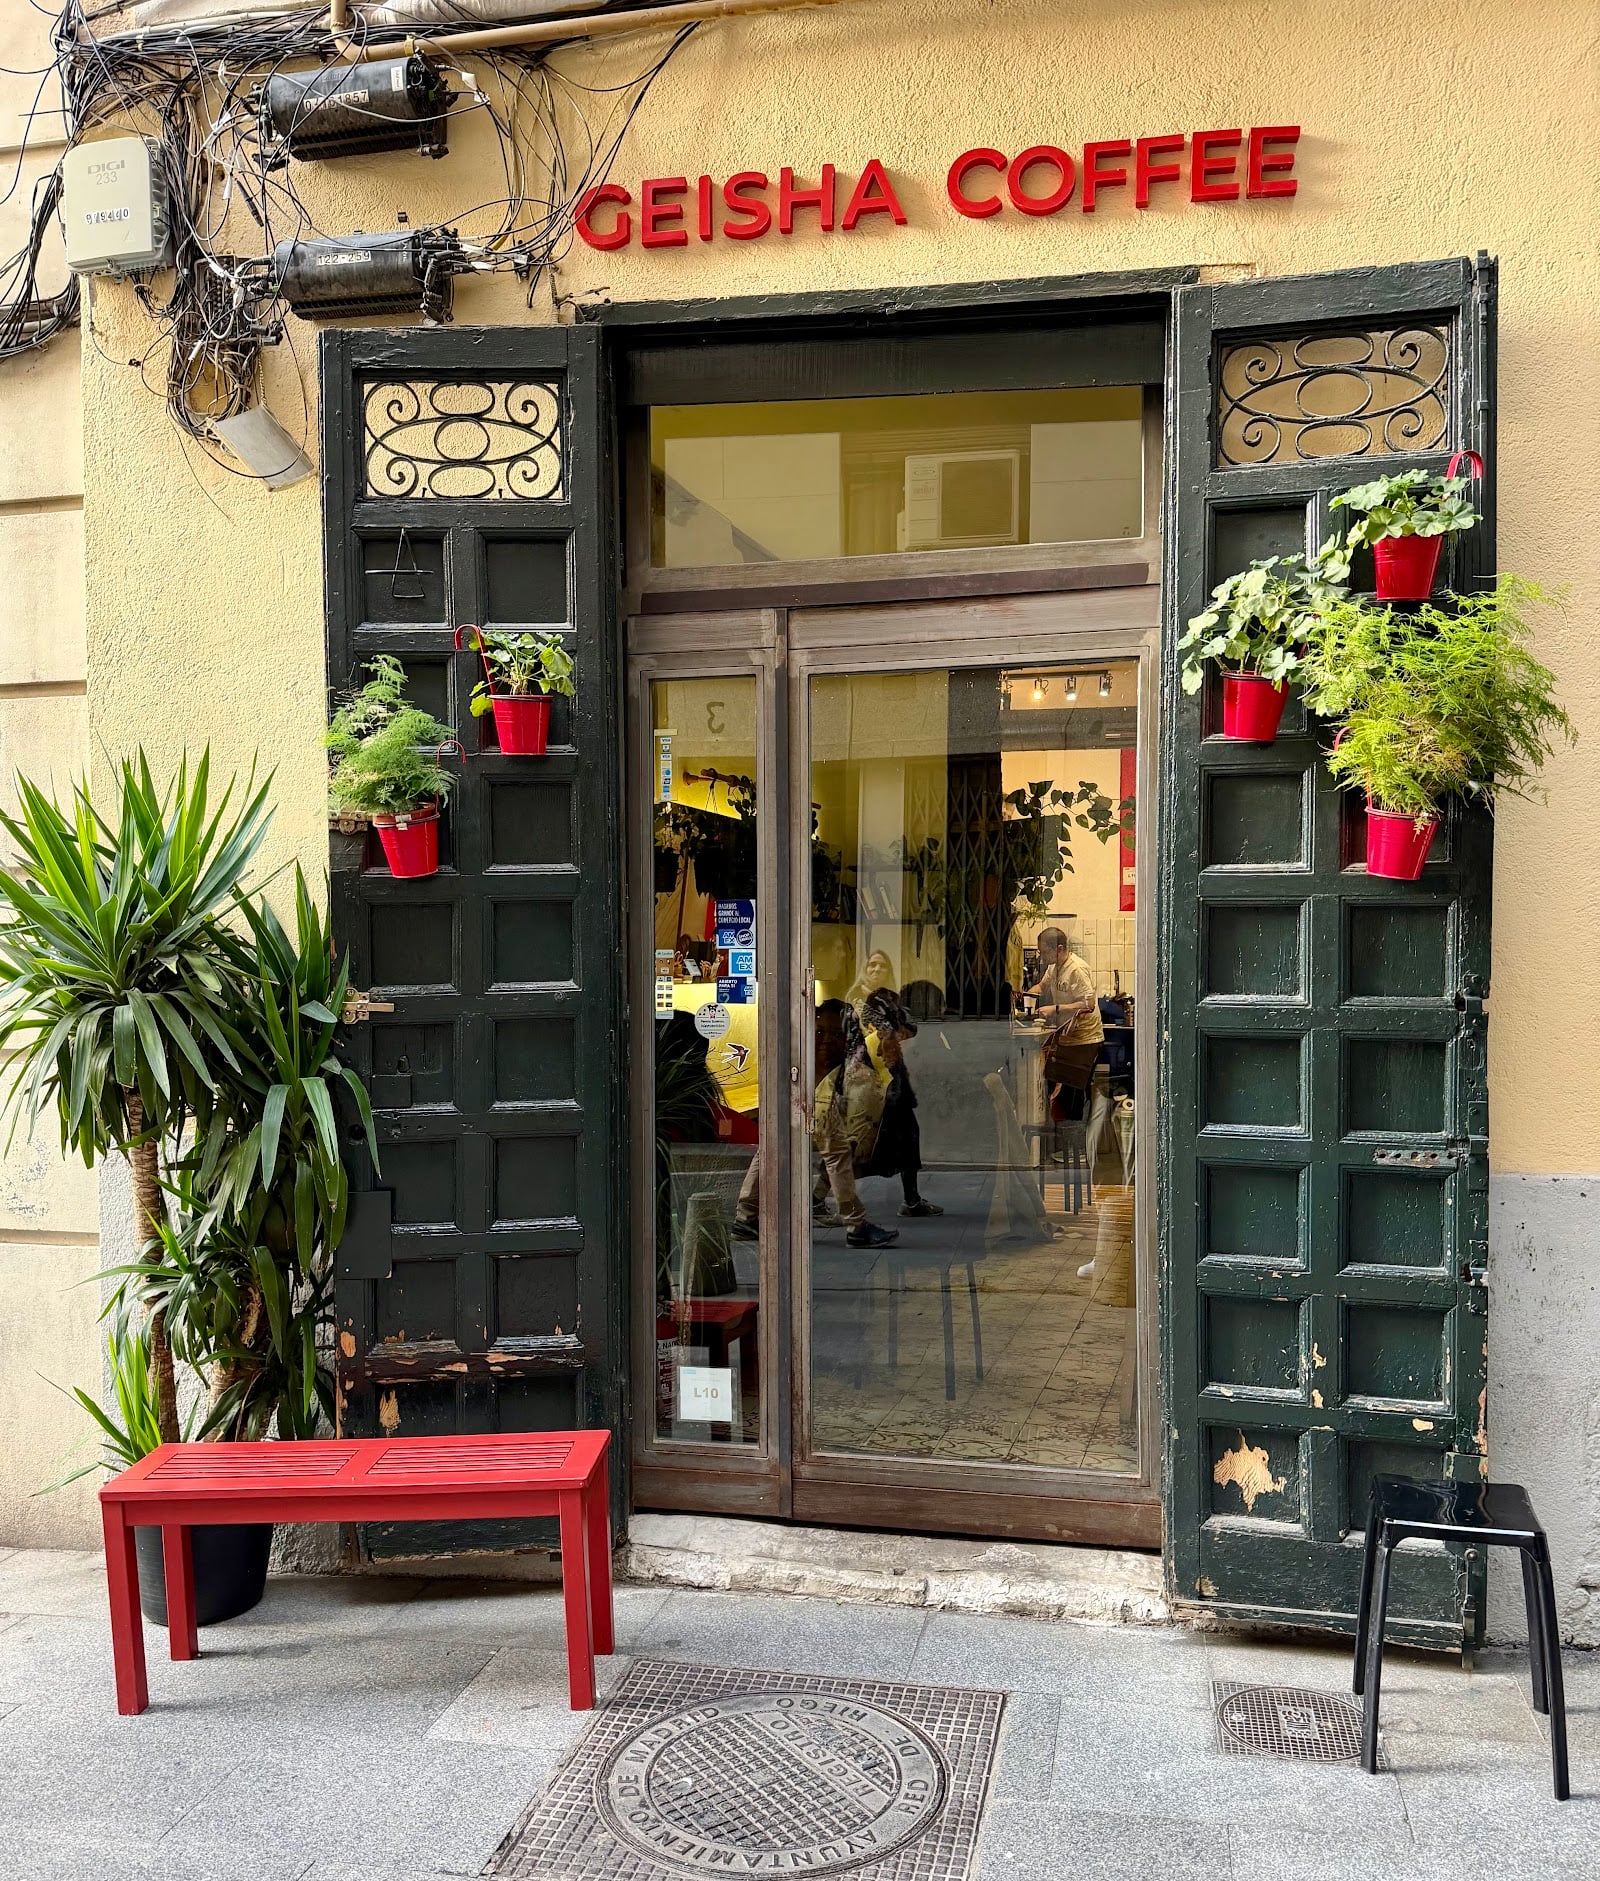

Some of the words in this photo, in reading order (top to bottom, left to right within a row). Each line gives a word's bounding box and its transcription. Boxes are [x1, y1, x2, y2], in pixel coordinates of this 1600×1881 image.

[87, 160, 126, 174] DIGI
[96, 171, 118, 185] 233
[575, 158, 908, 250] GEISHA
[947, 125, 1301, 219] COFFEE
[317, 251, 371, 266] 122-259
[738, 955, 753, 963] AM
[694, 1387, 719, 1399] L10
[776, 1697, 868, 1723] RIEGO
[630, 1706, 720, 1763] MADRID
[889, 1734, 921, 1759] DE
[770, 1718, 875, 1798] REGISTRO
[618, 1774, 642, 1798] DE
[899, 1778, 930, 1815] RED
[628, 1810, 877, 1869] AYUNTAMIENTO
